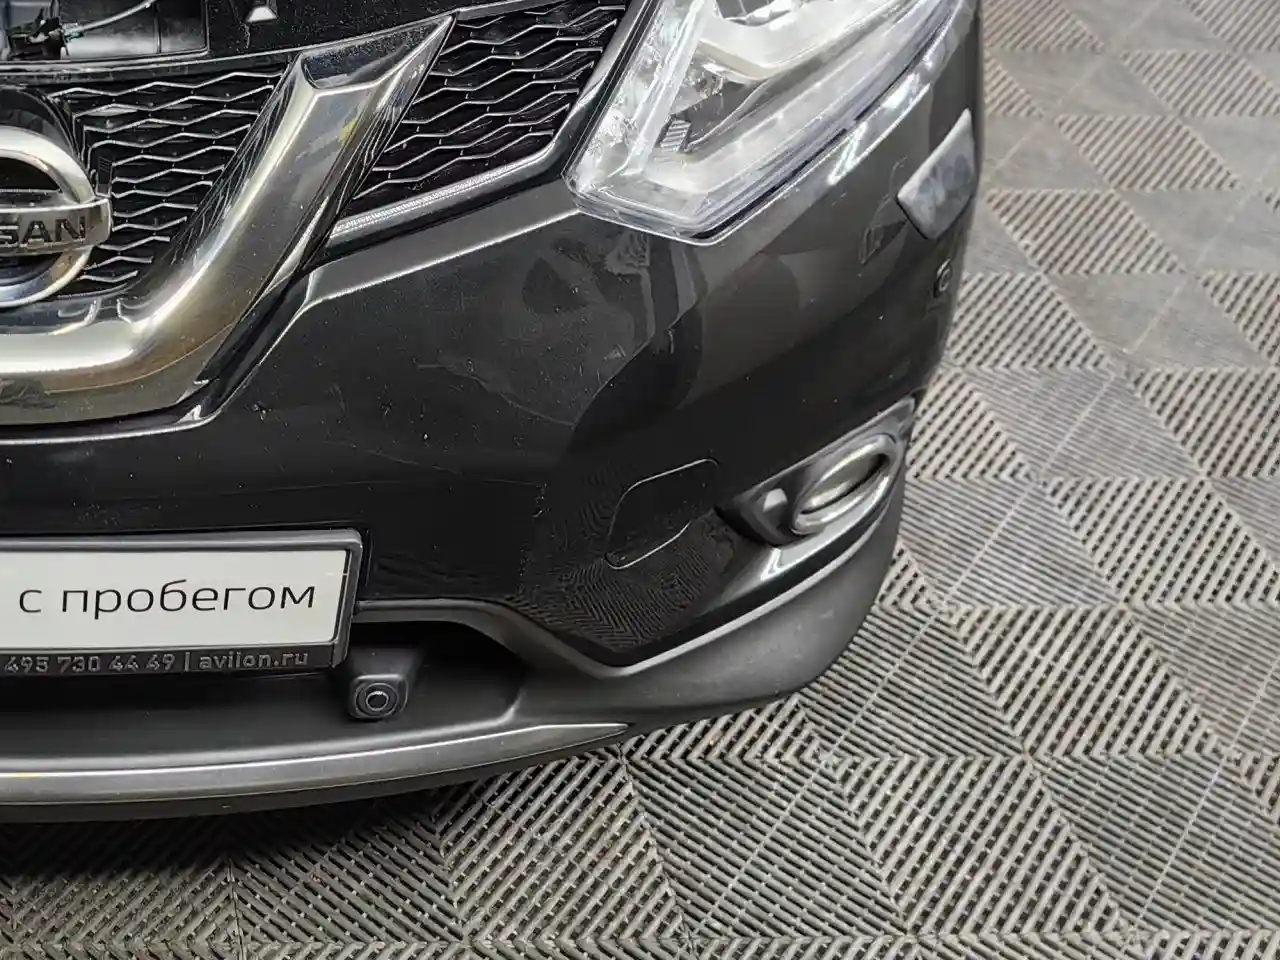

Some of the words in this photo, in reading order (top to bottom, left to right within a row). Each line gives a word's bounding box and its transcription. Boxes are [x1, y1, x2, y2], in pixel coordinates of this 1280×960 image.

[19, 589, 42, 613] с
[61, 579, 316, 620] пробегом
[4, 656, 49, 673] 495
[57, 655, 101, 672] 730
[108, 655, 139, 671] 44
[146, 654, 176, 671] 49
[199, 650, 309, 670] avilon.ru
